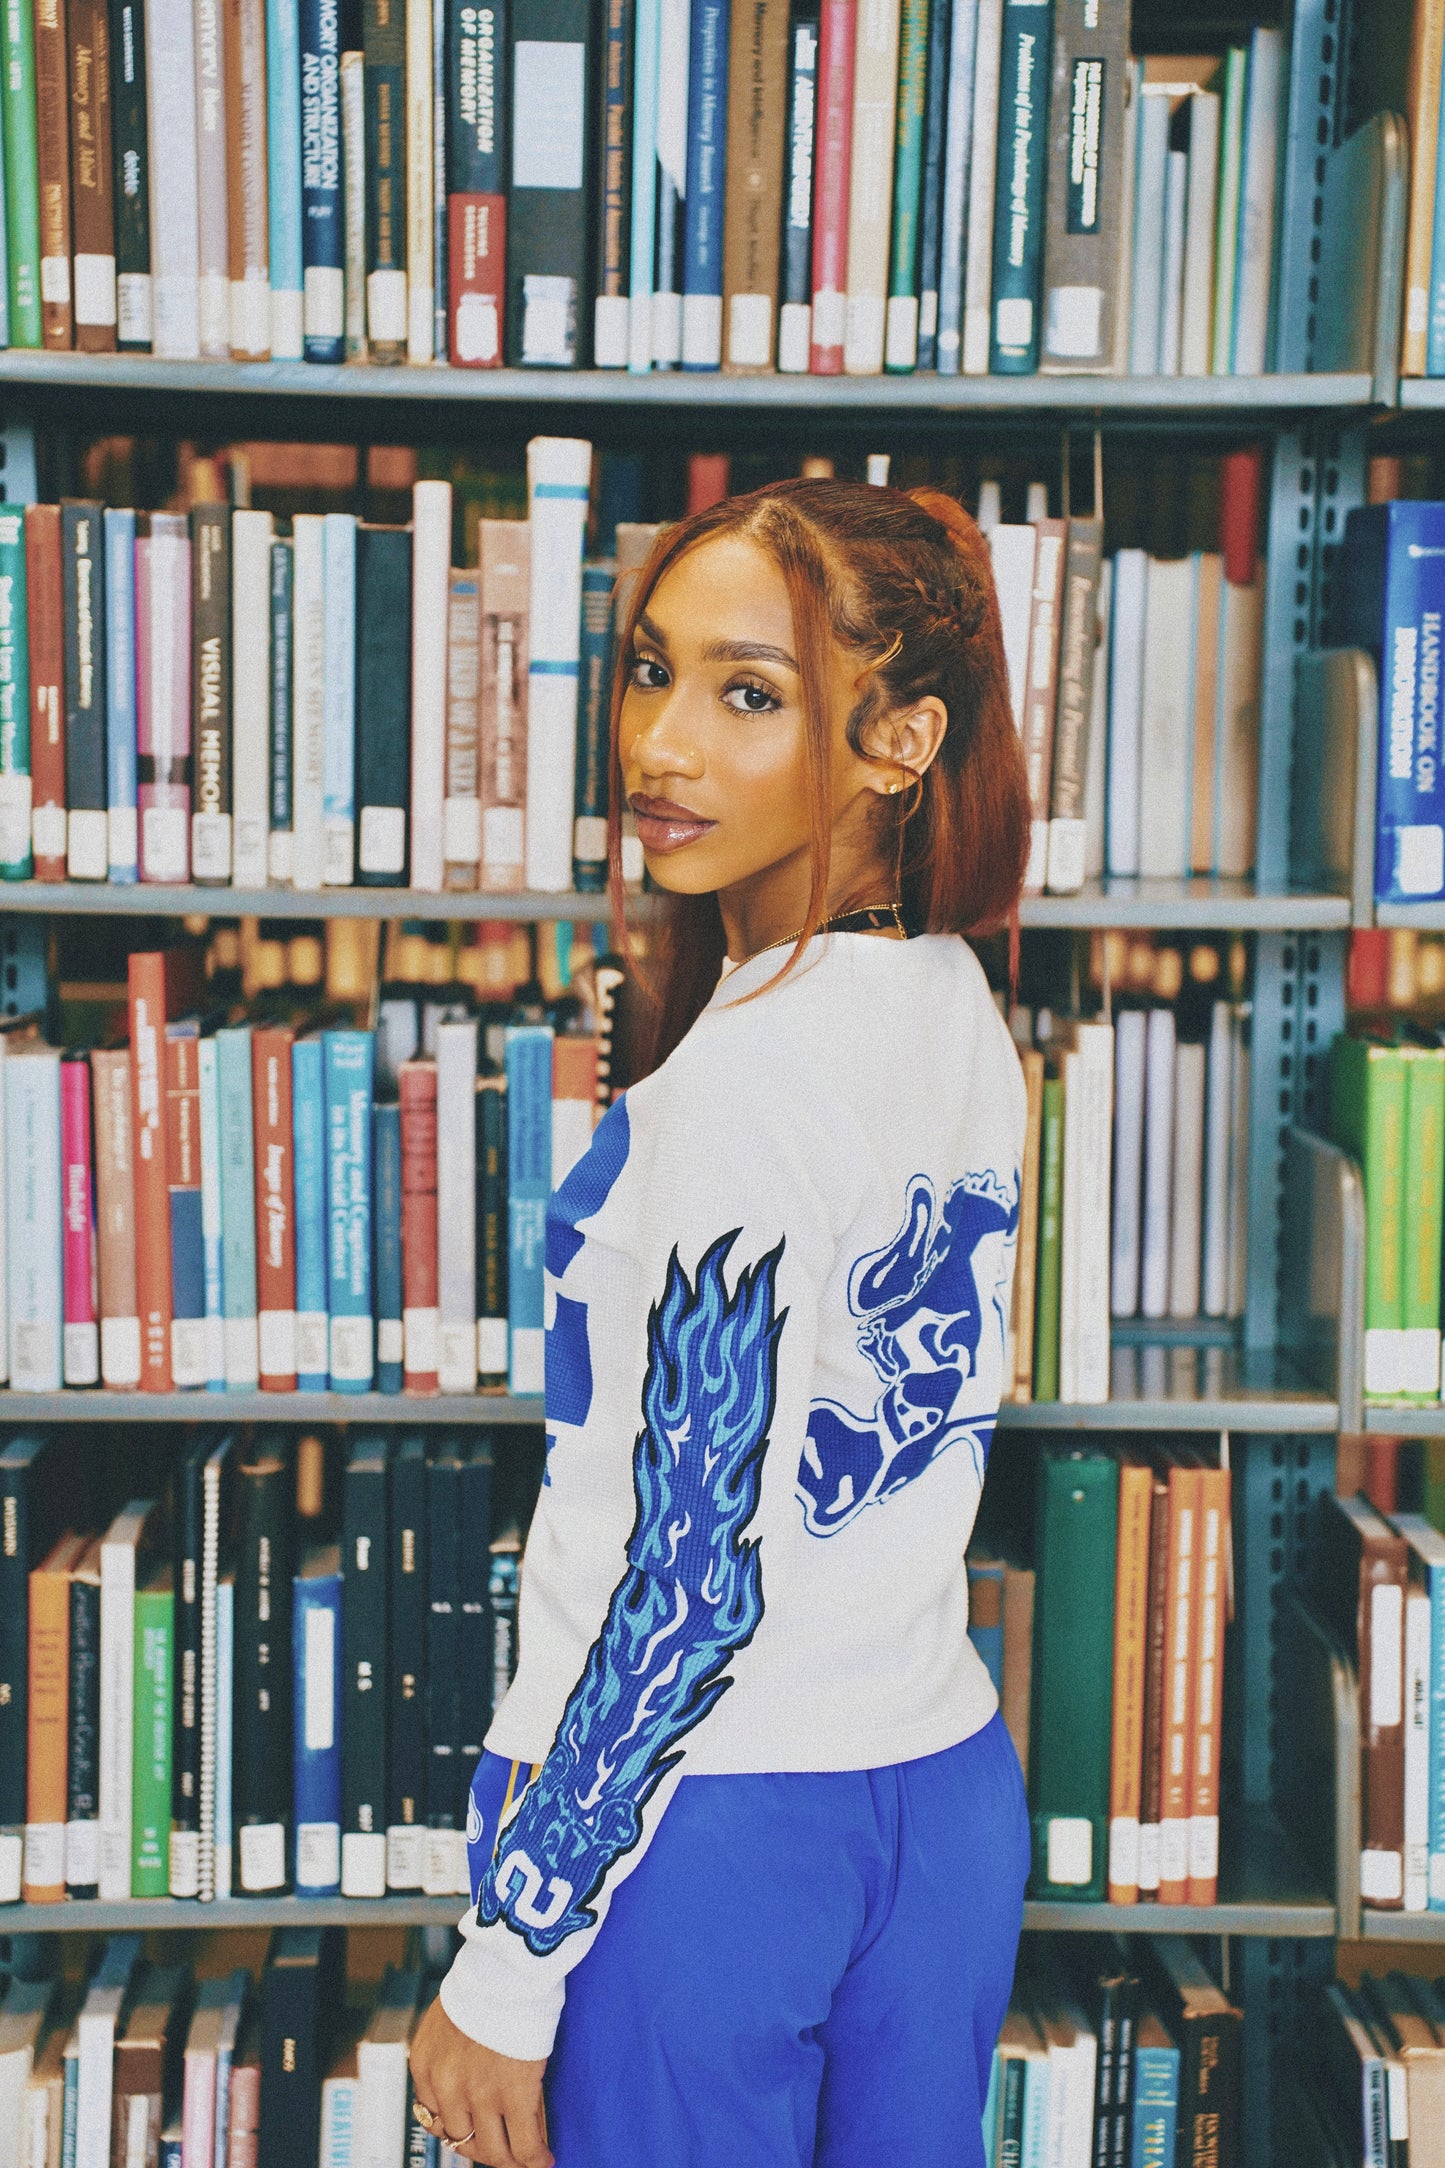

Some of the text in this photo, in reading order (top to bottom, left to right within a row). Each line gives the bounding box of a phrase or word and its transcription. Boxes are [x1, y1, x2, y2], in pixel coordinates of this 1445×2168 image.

[319, 0, 339, 54] MORY
[699, 6, 720, 75] Perspectives
[752, 2, 767, 55] Memory
[302, 53, 322, 96] AND
[460, 8, 477, 125] OF MEMORY
[477, 9, 495, 153] ORGANIZATION
[753, 58, 766, 82] and
[72, 44, 97, 189] Memory and Mind
[303, 97, 322, 189] STRUCTURE
[318, 53, 340, 190] ORGANIZATION
[698, 94, 717, 141] Memory
[1007, 33, 1036, 267] Problems of the Psychology of Memory
[123, 150, 140, 196] delete
[201, 637, 222, 816] VISUAL MEMOR
[1414, 613, 1443, 793] HANDBOOK ON
[349, 1090, 368, 1164] Memory
[332, 1152, 350, 1207] Social
[350, 1167, 368, 1204] and
[332, 1208, 349, 1280] Context
[348, 1204, 370, 1296] Cognition
[410, 2125, 427, 2153] THE
